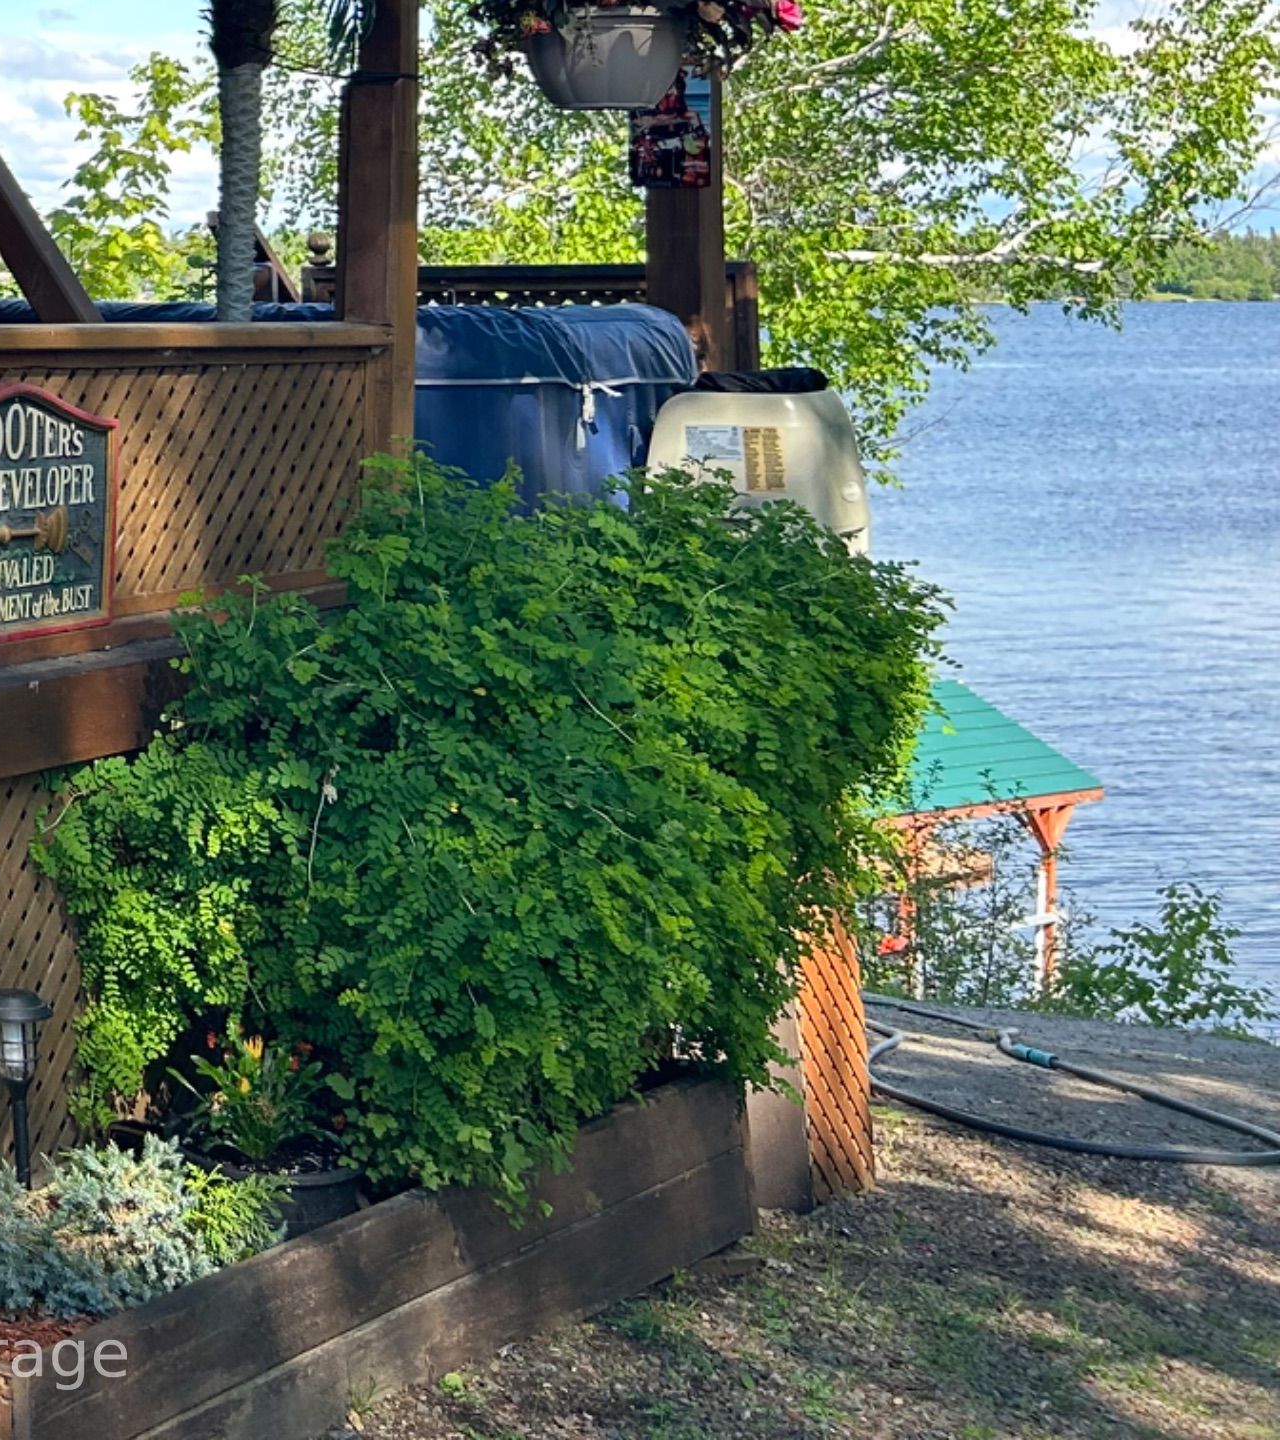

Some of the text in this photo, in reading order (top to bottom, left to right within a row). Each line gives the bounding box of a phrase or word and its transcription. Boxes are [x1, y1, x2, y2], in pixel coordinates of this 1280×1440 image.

[32, 594, 44, 619] of
[43, 589, 60, 616] the
[62, 585, 93, 612] BUST
